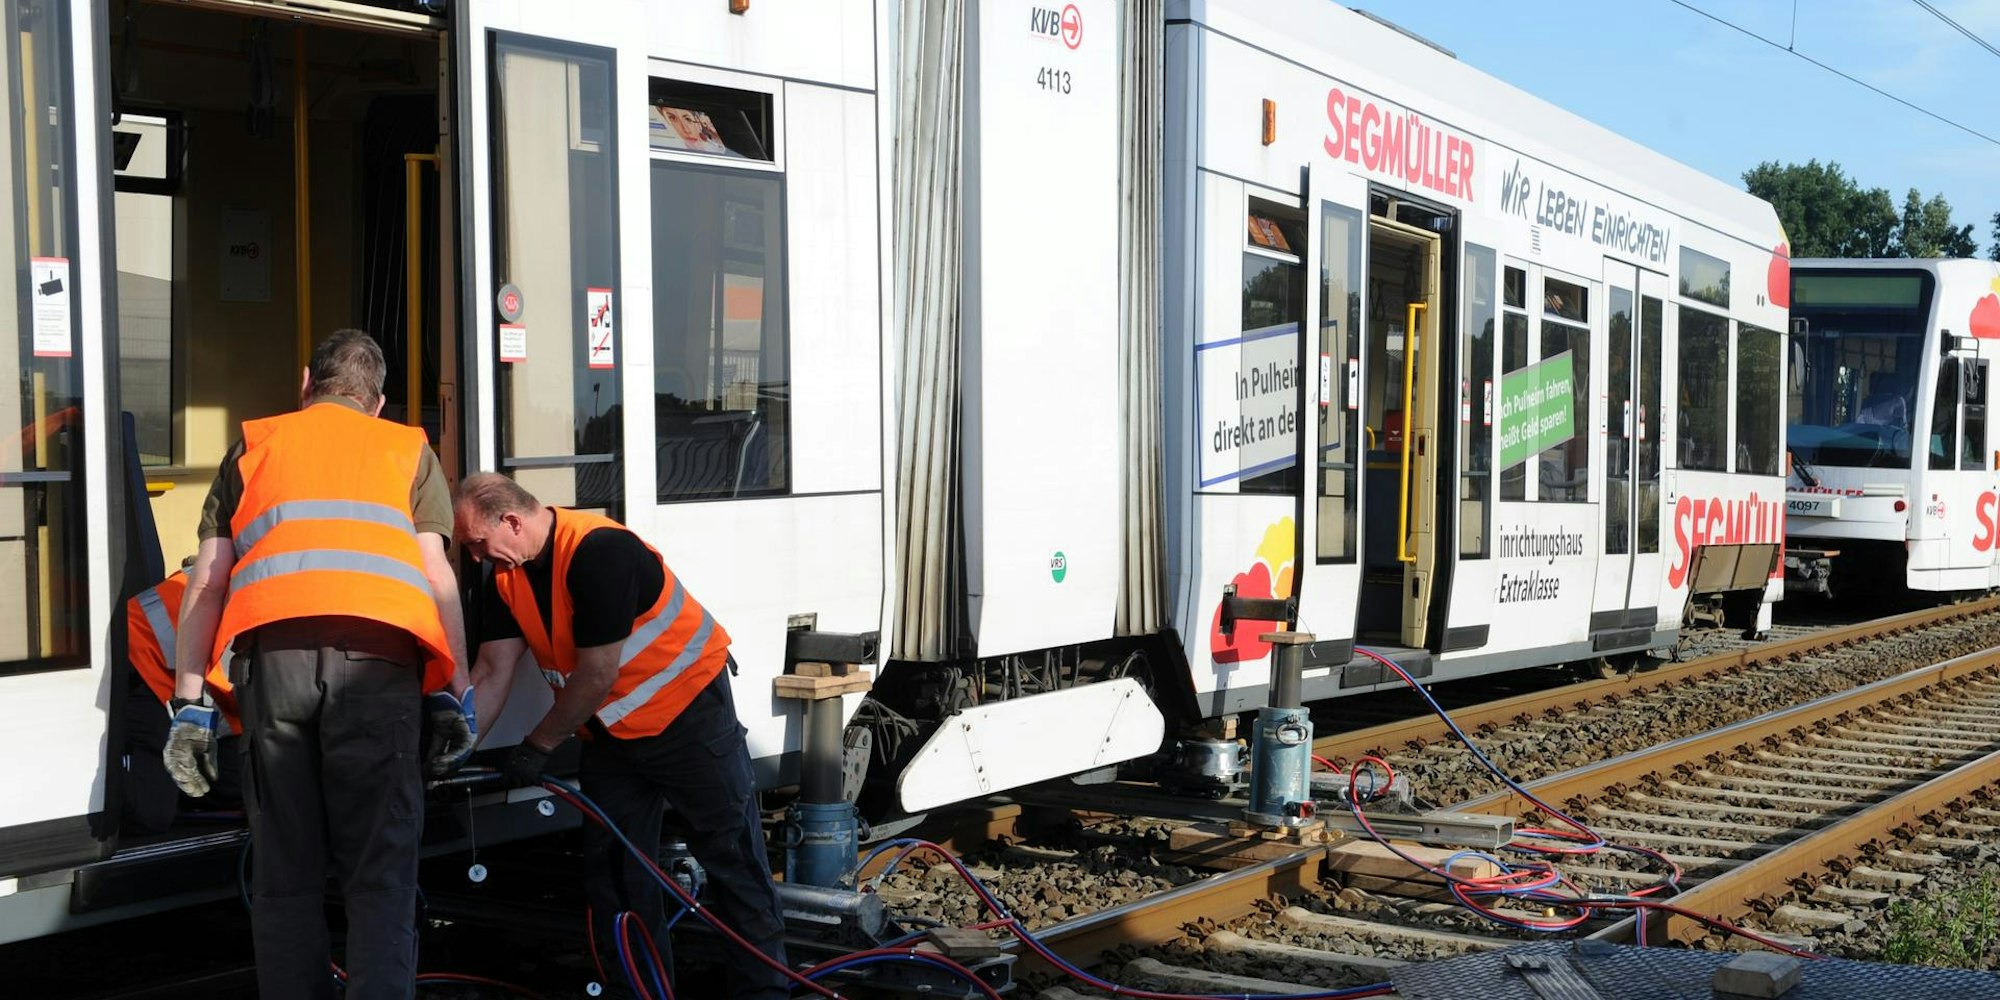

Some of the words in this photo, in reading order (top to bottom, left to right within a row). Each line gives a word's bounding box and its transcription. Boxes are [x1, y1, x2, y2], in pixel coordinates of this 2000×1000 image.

[1031, 7, 1060, 36] KVB
[1037, 66, 1071, 95] 4113
[1324, 88, 1473, 202] SEGMÜLLER
[1536, 180, 1587, 238] LEBEN
[1235, 371, 1248, 401] In
[1213, 415, 1255, 453] direkt
[1258, 415, 1275, 441] an
[1521, 416, 1539, 440] Geld
[1540, 405, 1567, 437] sparen!
[1789, 501, 1820, 511] 4097
[1051, 558, 1063, 569] VRS
[1499, 570, 1560, 604] Extraklasse
